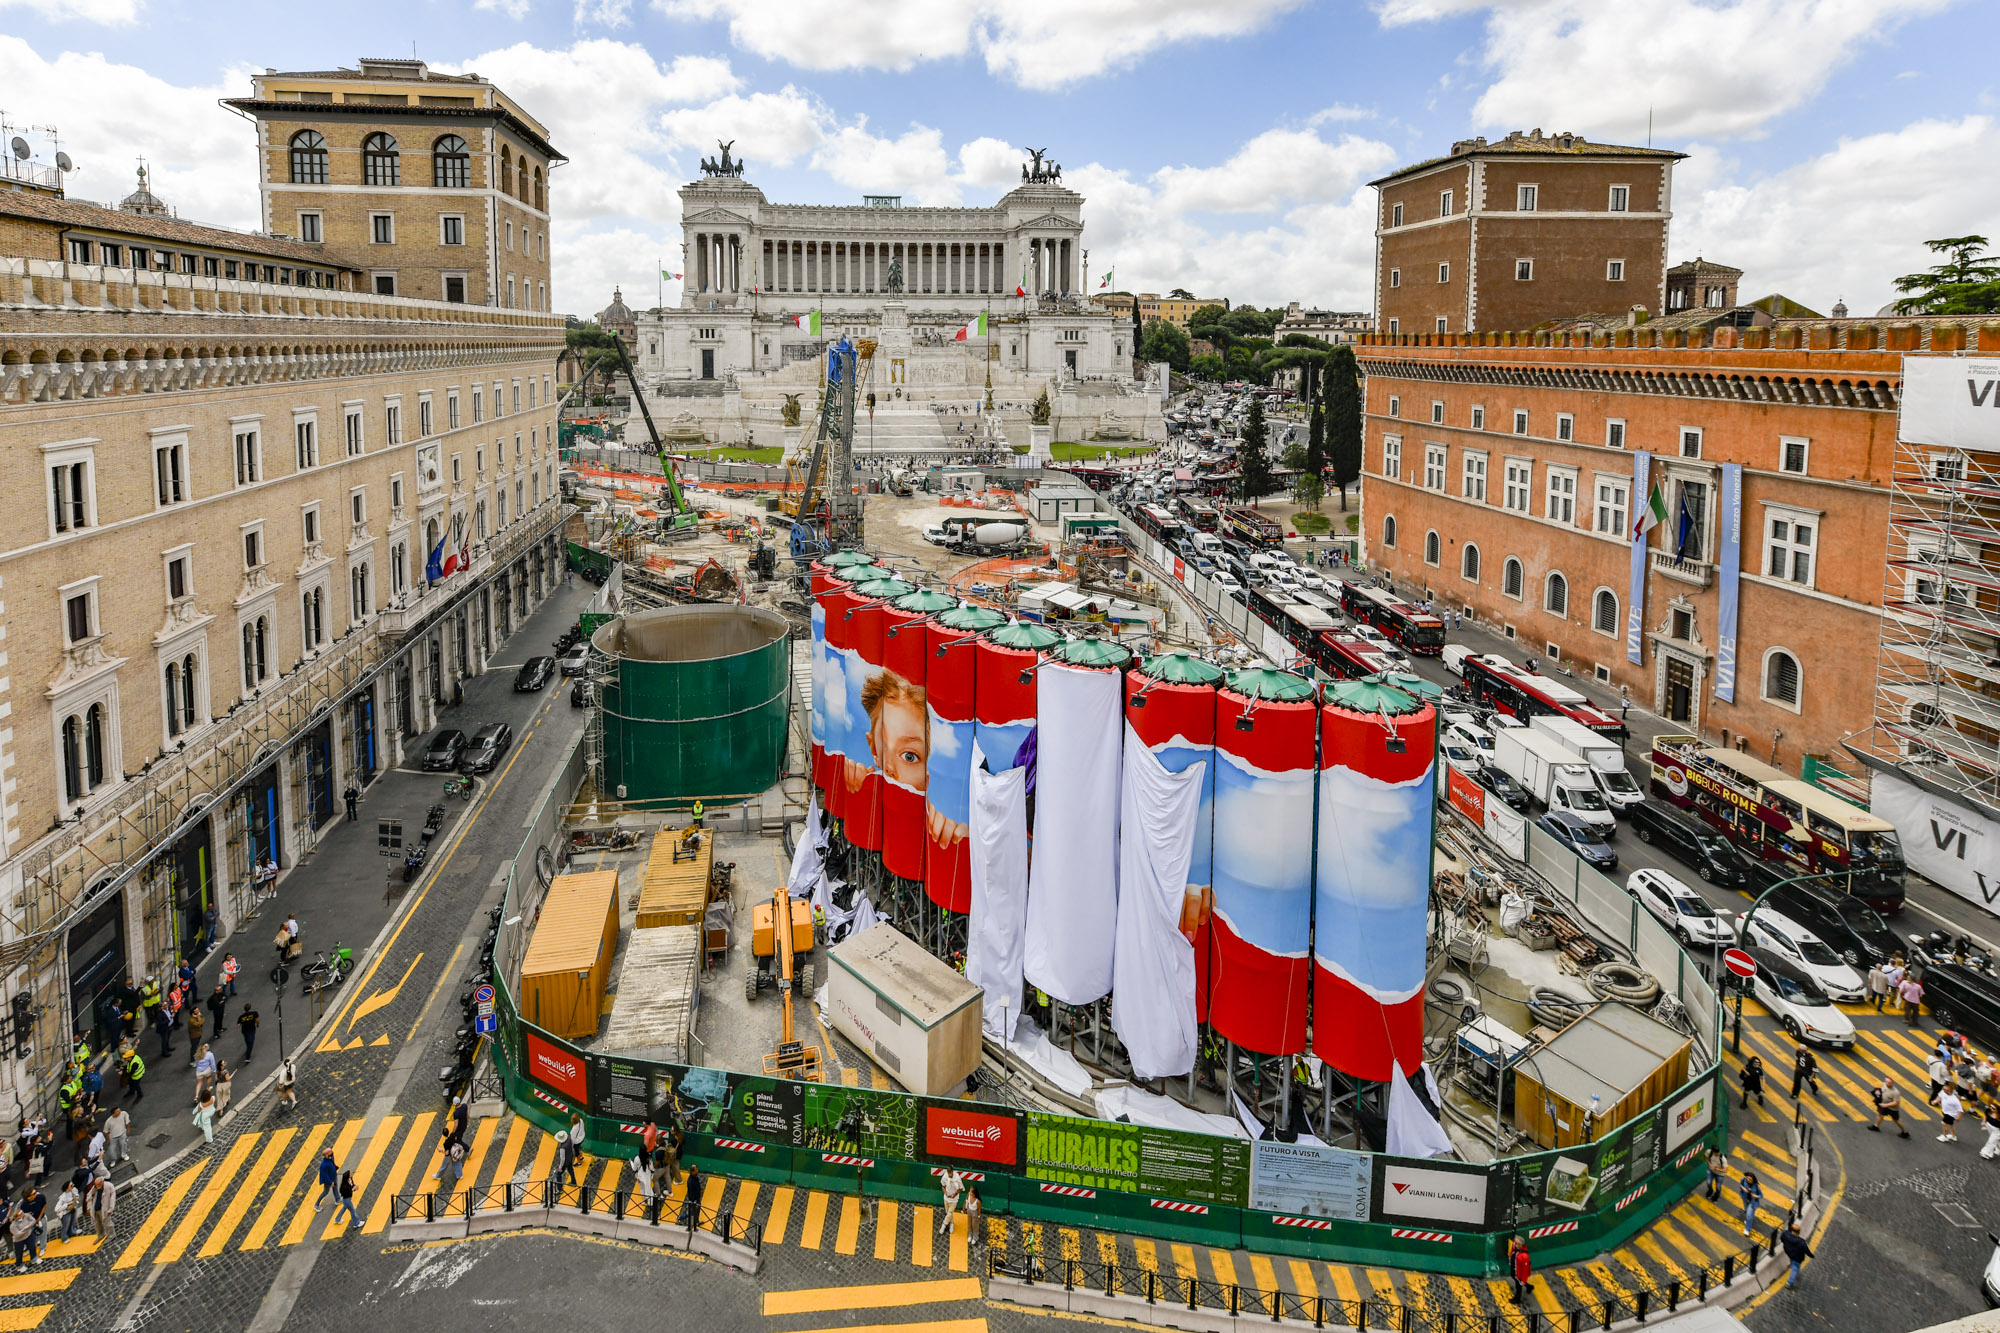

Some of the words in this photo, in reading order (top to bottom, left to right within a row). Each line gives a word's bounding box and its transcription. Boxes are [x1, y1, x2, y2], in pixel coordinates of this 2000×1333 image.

[1733, 468, 1741, 509] Venezia
[1731, 510, 1740, 544] Palazzo
[1627, 605, 1642, 655] VIVE
[1717, 635, 1736, 690] VIVE
[1723, 788, 1758, 815] ROME
[1931, 804, 1961, 821] Vittoriano
[1936, 811, 1960, 827] Palazzo
[538, 1053, 566, 1073] webuild
[611, 1062, 634, 1070] Stazione
[611, 1067, 632, 1075] Venezia
[743, 1092, 755, 1107] 6
[756, 1093, 773, 1103] piani
[756, 1100, 783, 1110] interrati
[743, 1111, 754, 1126] 3
[756, 1113, 778, 1124] accessi
[778, 1116, 786, 1124] in
[756, 1119, 788, 1131] superficie
[792, 1113, 802, 1145] ROMA
[942, 1126, 984, 1138] webuild
[905, 1127, 914, 1159] ROMA
[1027, 1127, 1139, 1173] MURALES
[1260, 1145, 1291, 1155] FUTURO
[1299, 1150, 1320, 1158] VISTA
[1652, 1136, 1660, 1170] ROMA
[1026, 1156, 1045, 1167] Arte
[1046, 1159, 1104, 1175] contemporanea
[1105, 1167, 1113, 1175] in
[1114, 1169, 1138, 1178] metro
[1355, 1186, 1367, 1219] ROMA
[1408, 1189, 1436, 1198] VIANINI
[1437, 1192, 1463, 1201] LAVORI
